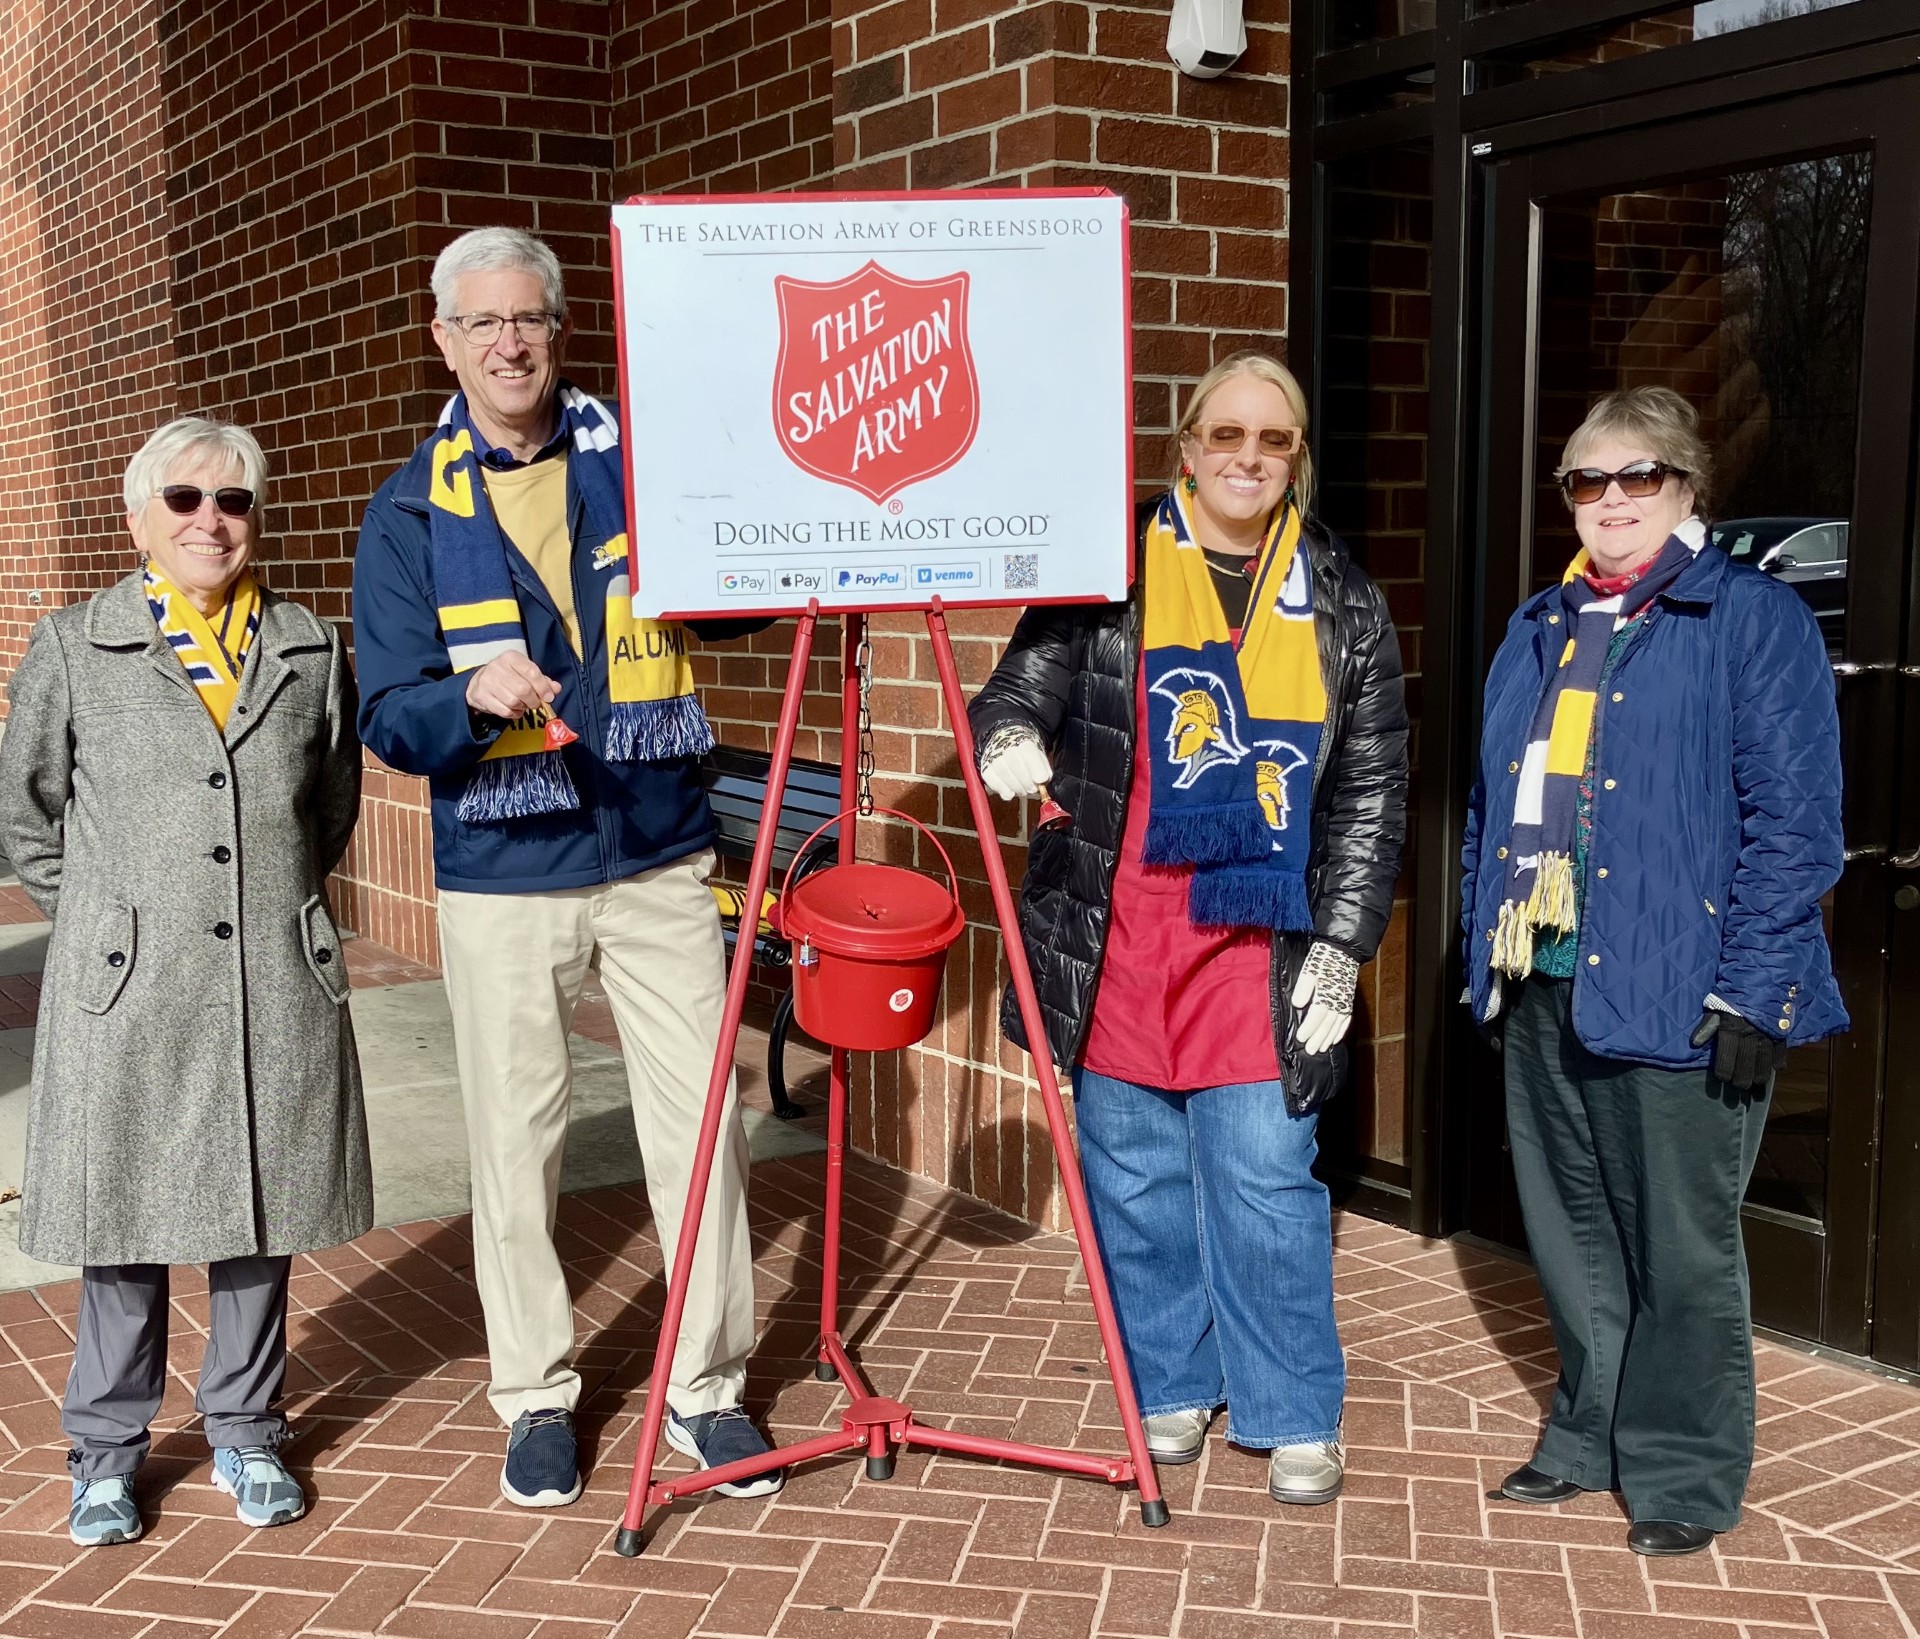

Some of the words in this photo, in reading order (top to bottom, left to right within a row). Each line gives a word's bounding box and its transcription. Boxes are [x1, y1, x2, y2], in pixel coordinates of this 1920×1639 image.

[639, 224, 687, 243] THE
[698, 222, 823, 242] SALVATION
[835, 220, 900, 239] ARMY
[909, 221, 937, 238] OF
[947, 218, 1103, 238] GREENSBORO
[811, 288, 886, 364] THE
[789, 298, 952, 443] SALVATION
[850, 365, 949, 474] ARMY
[714, 521, 811, 546] DOING
[818, 520, 872, 543] THE
[880, 517, 955, 541] MOST
[740, 575, 765, 591] Pay
[794, 573, 821, 590] Pay
[855, 572, 899, 586] PayPal
[935, 570, 974, 580] venmo
